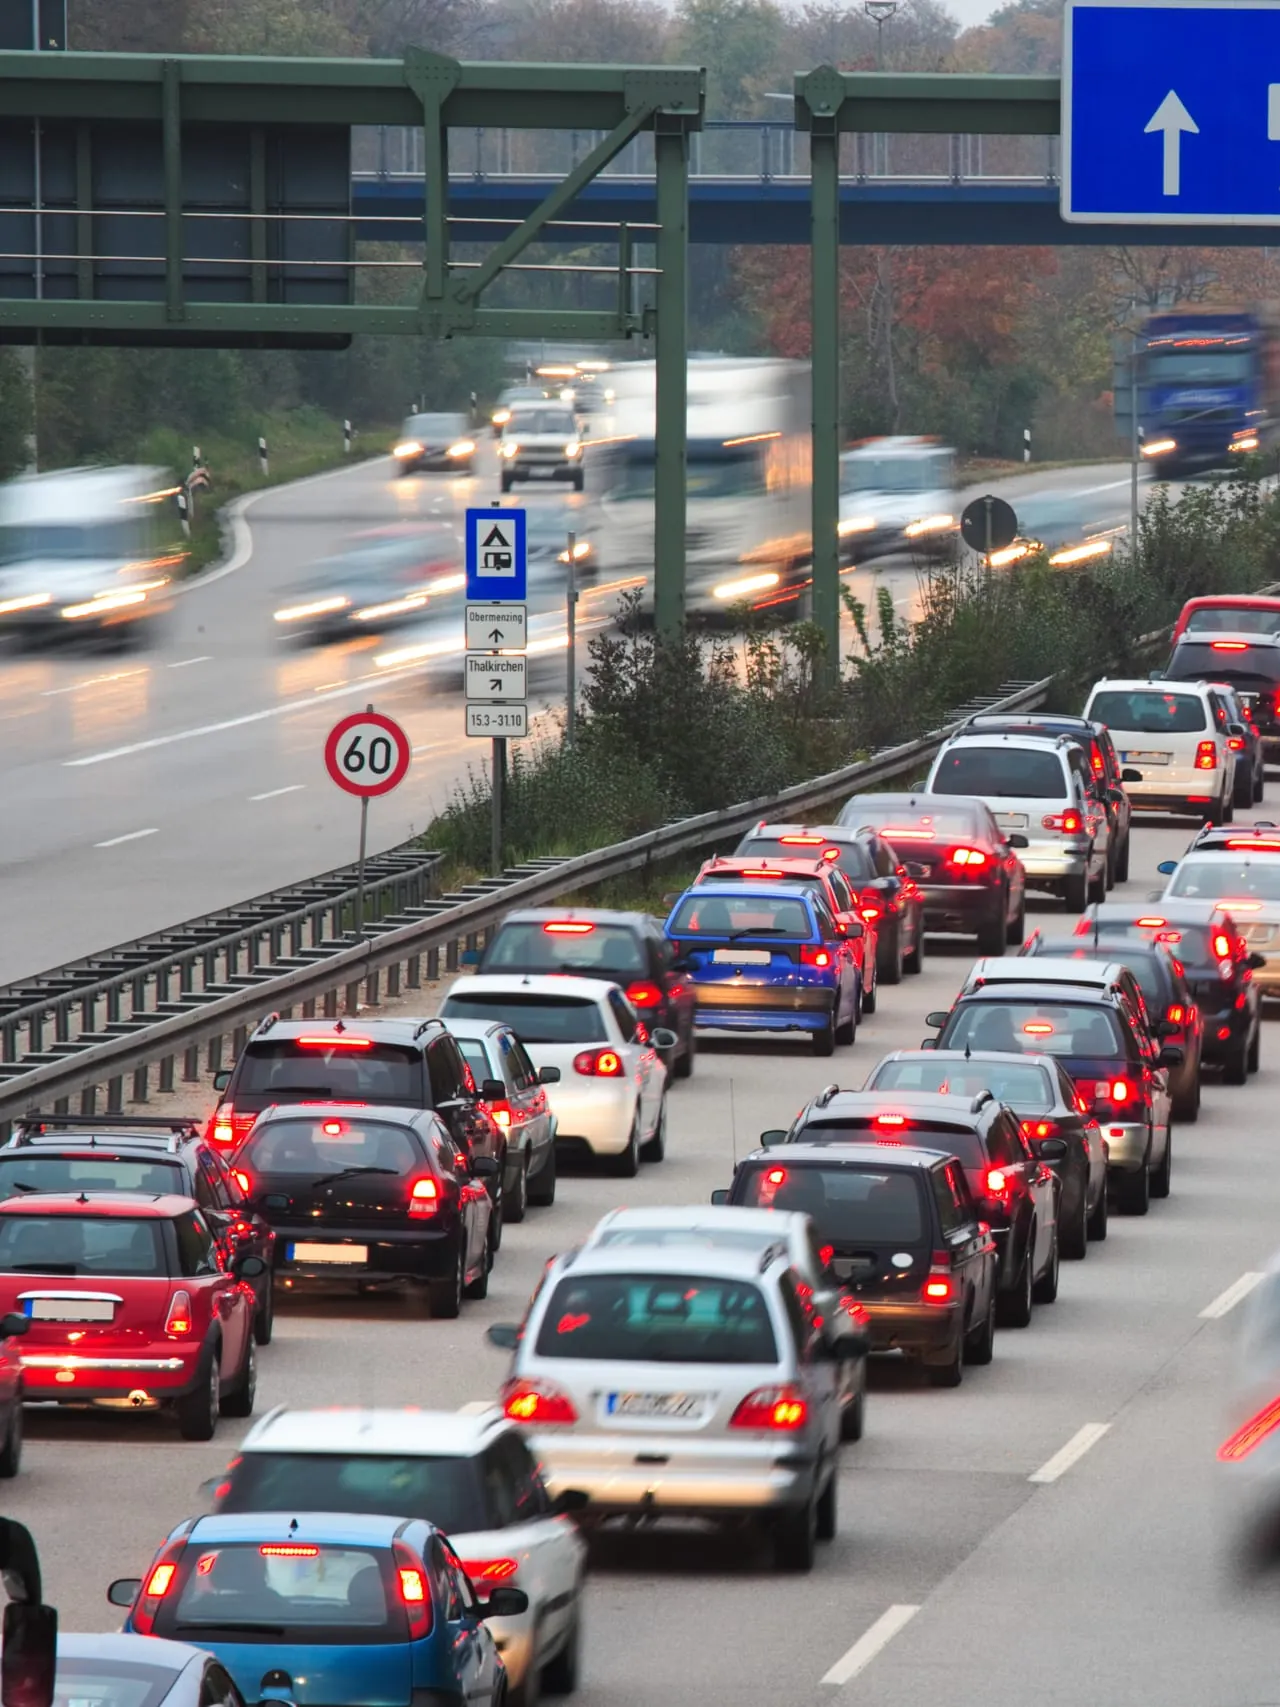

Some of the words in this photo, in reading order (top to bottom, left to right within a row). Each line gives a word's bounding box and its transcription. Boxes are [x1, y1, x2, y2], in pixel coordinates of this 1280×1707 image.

[469, 611, 523, 624] Obermenzing
[469, 660, 523, 673] Thalkirchen
[344, 735, 391, 774] 60
